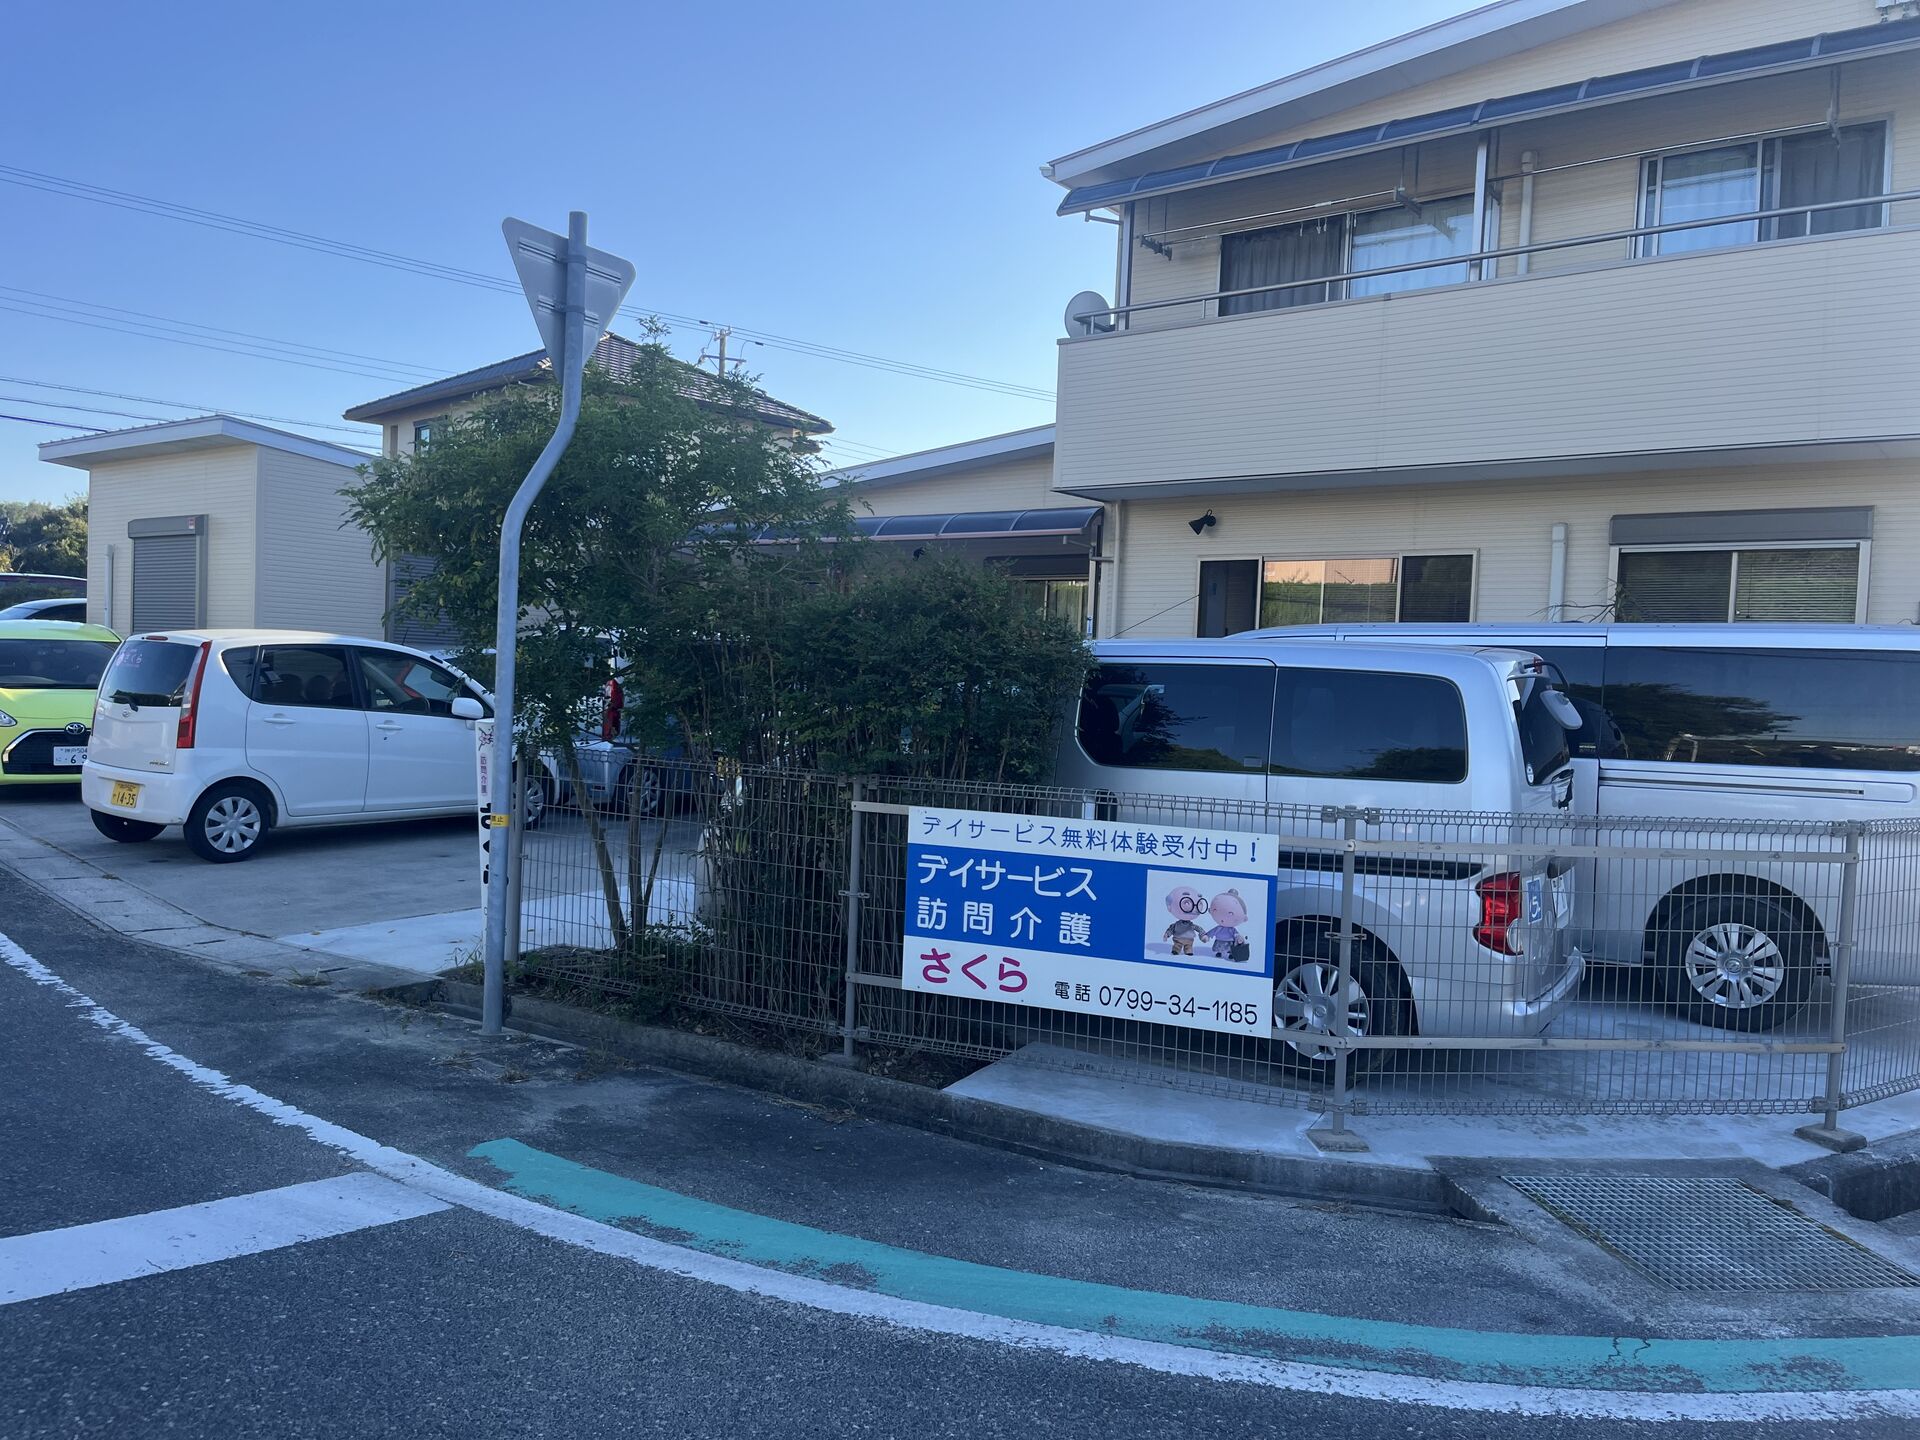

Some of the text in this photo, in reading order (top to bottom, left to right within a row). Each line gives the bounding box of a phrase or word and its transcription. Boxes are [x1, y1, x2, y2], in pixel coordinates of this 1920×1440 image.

[917, 854, 1098, 901] デイサービス
[916, 896, 1091, 947] 訪問介護
[919, 948, 1028, 993] さくら
[1054, 981, 1258, 1026] 電話 0799-34-1185
